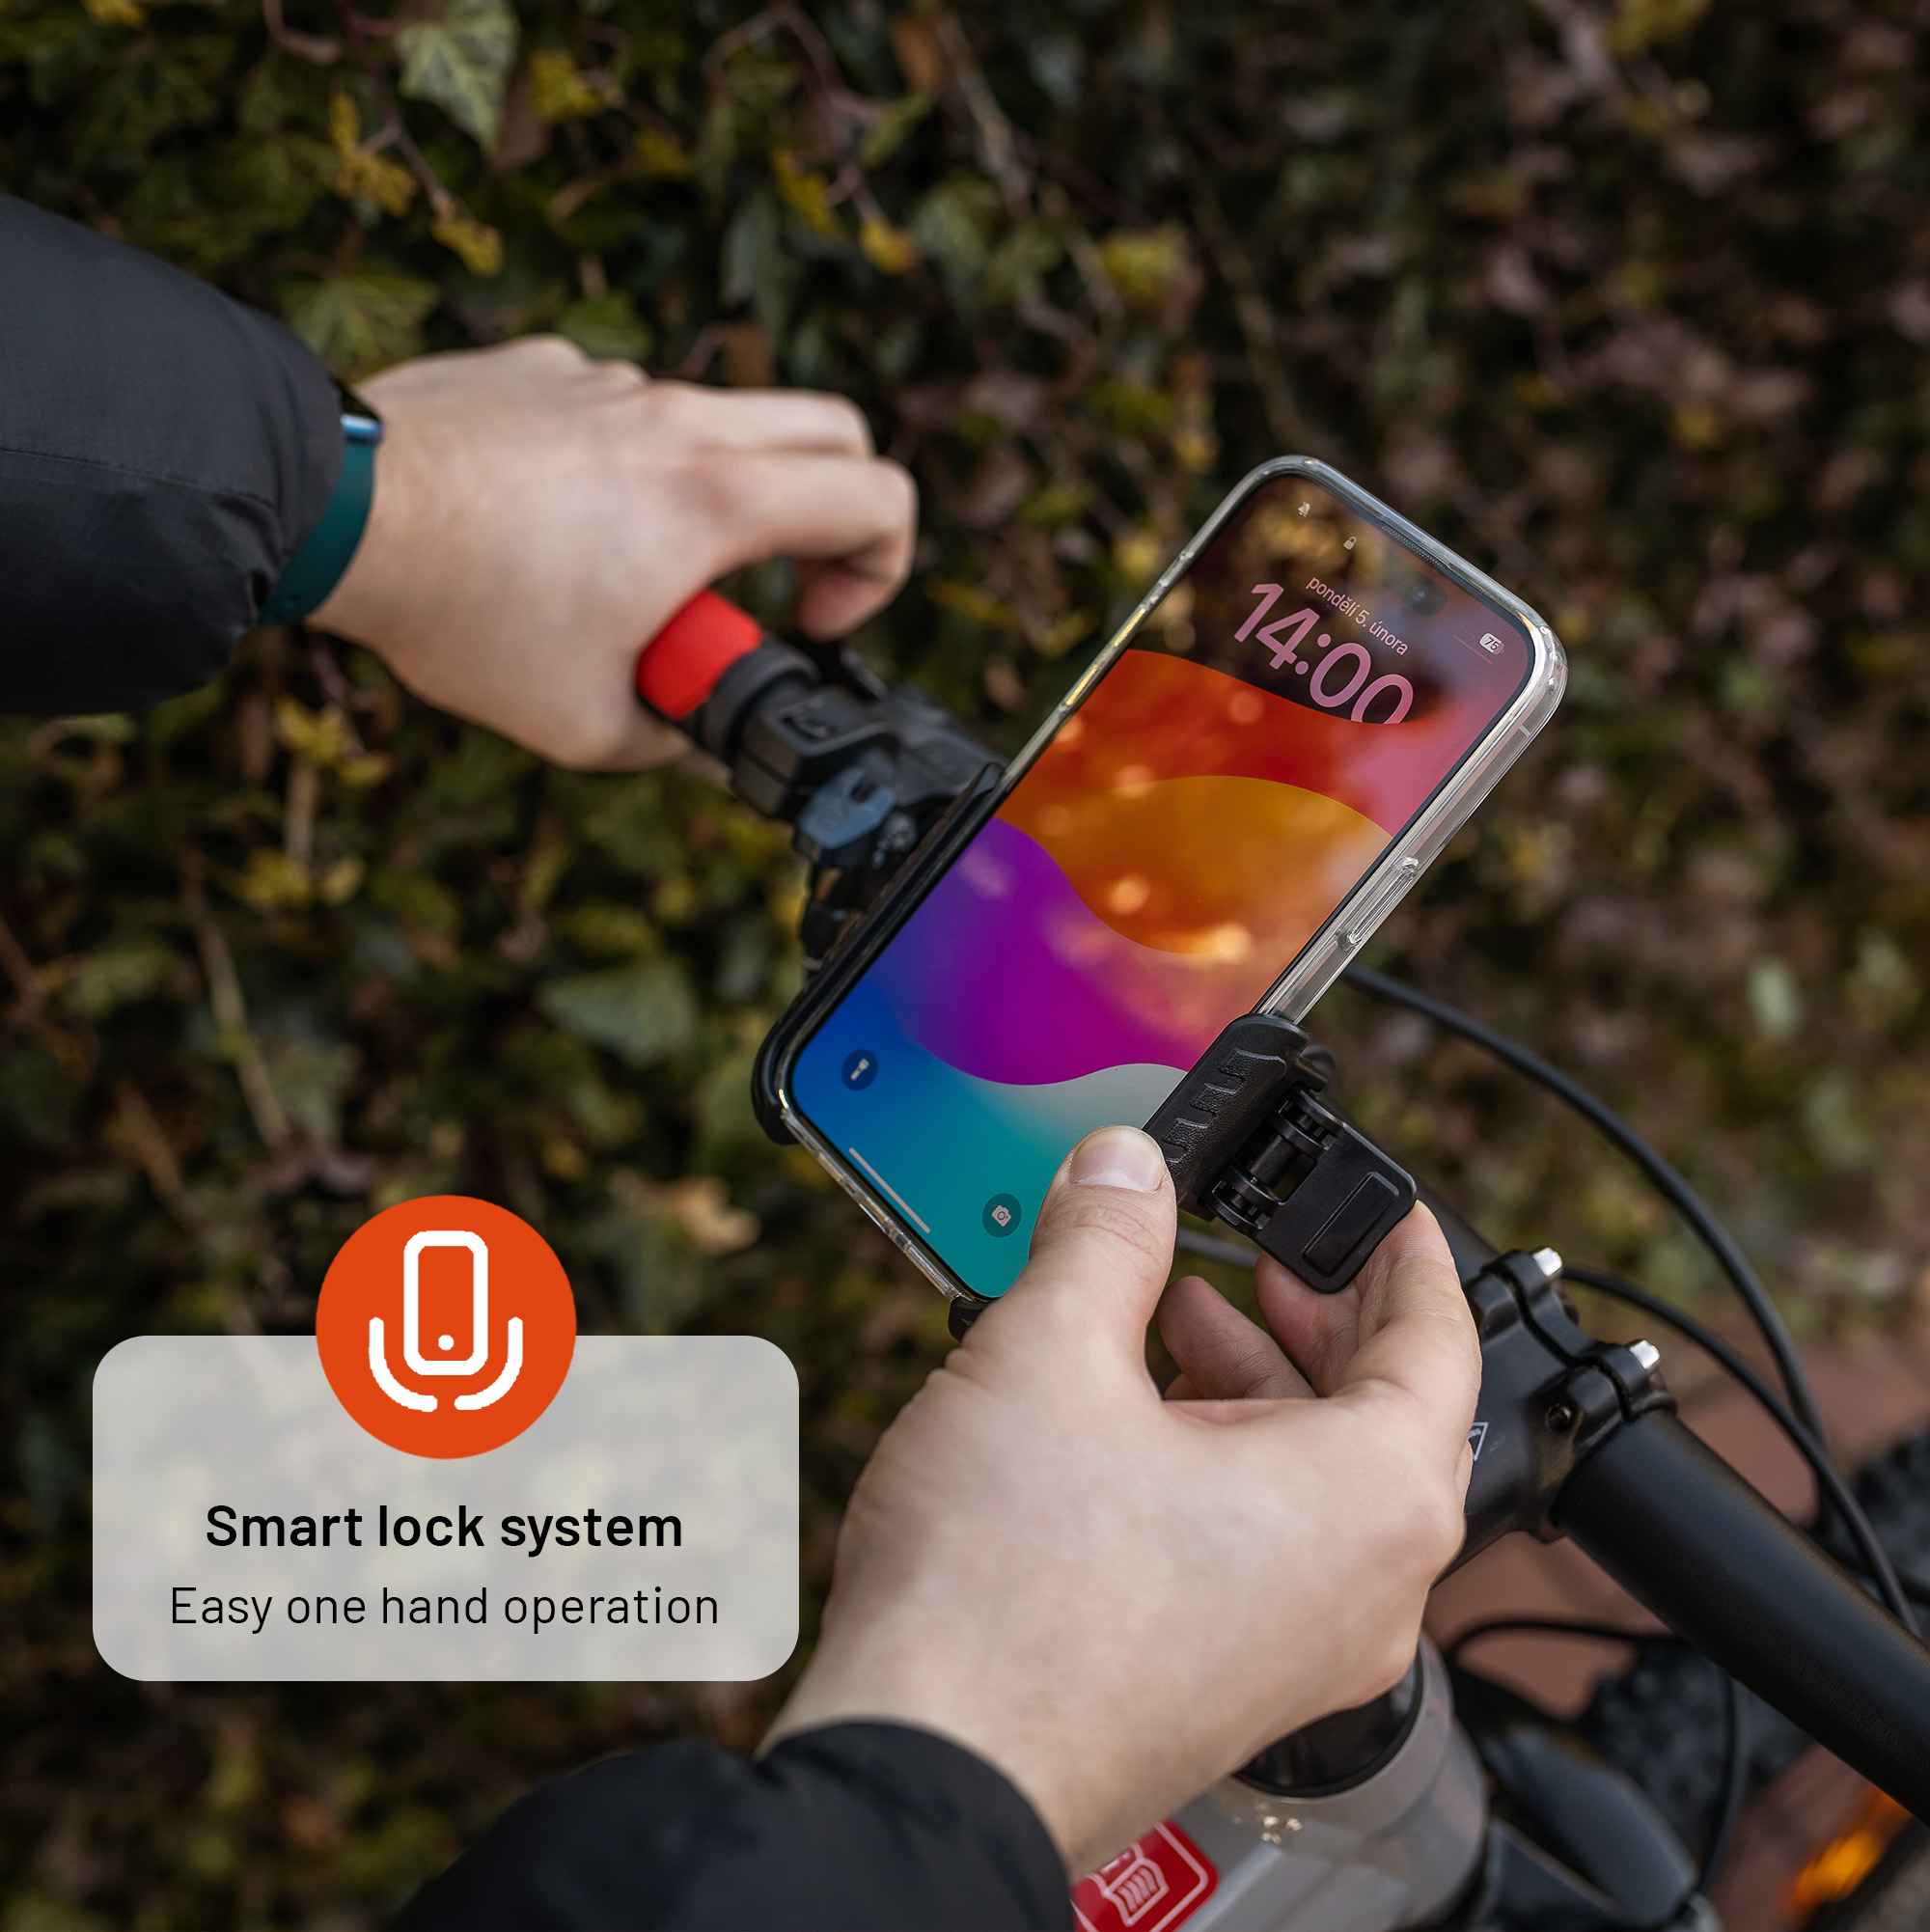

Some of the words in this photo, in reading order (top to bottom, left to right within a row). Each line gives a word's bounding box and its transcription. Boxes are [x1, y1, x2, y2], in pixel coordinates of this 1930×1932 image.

[1233, 583, 1414, 725] 14:00
[1306, 577, 1361, 618] pondělí
[1355, 610, 1370, 627] 5.
[1368, 621, 1409, 656] února
[1484, 636, 1501, 650] 75
